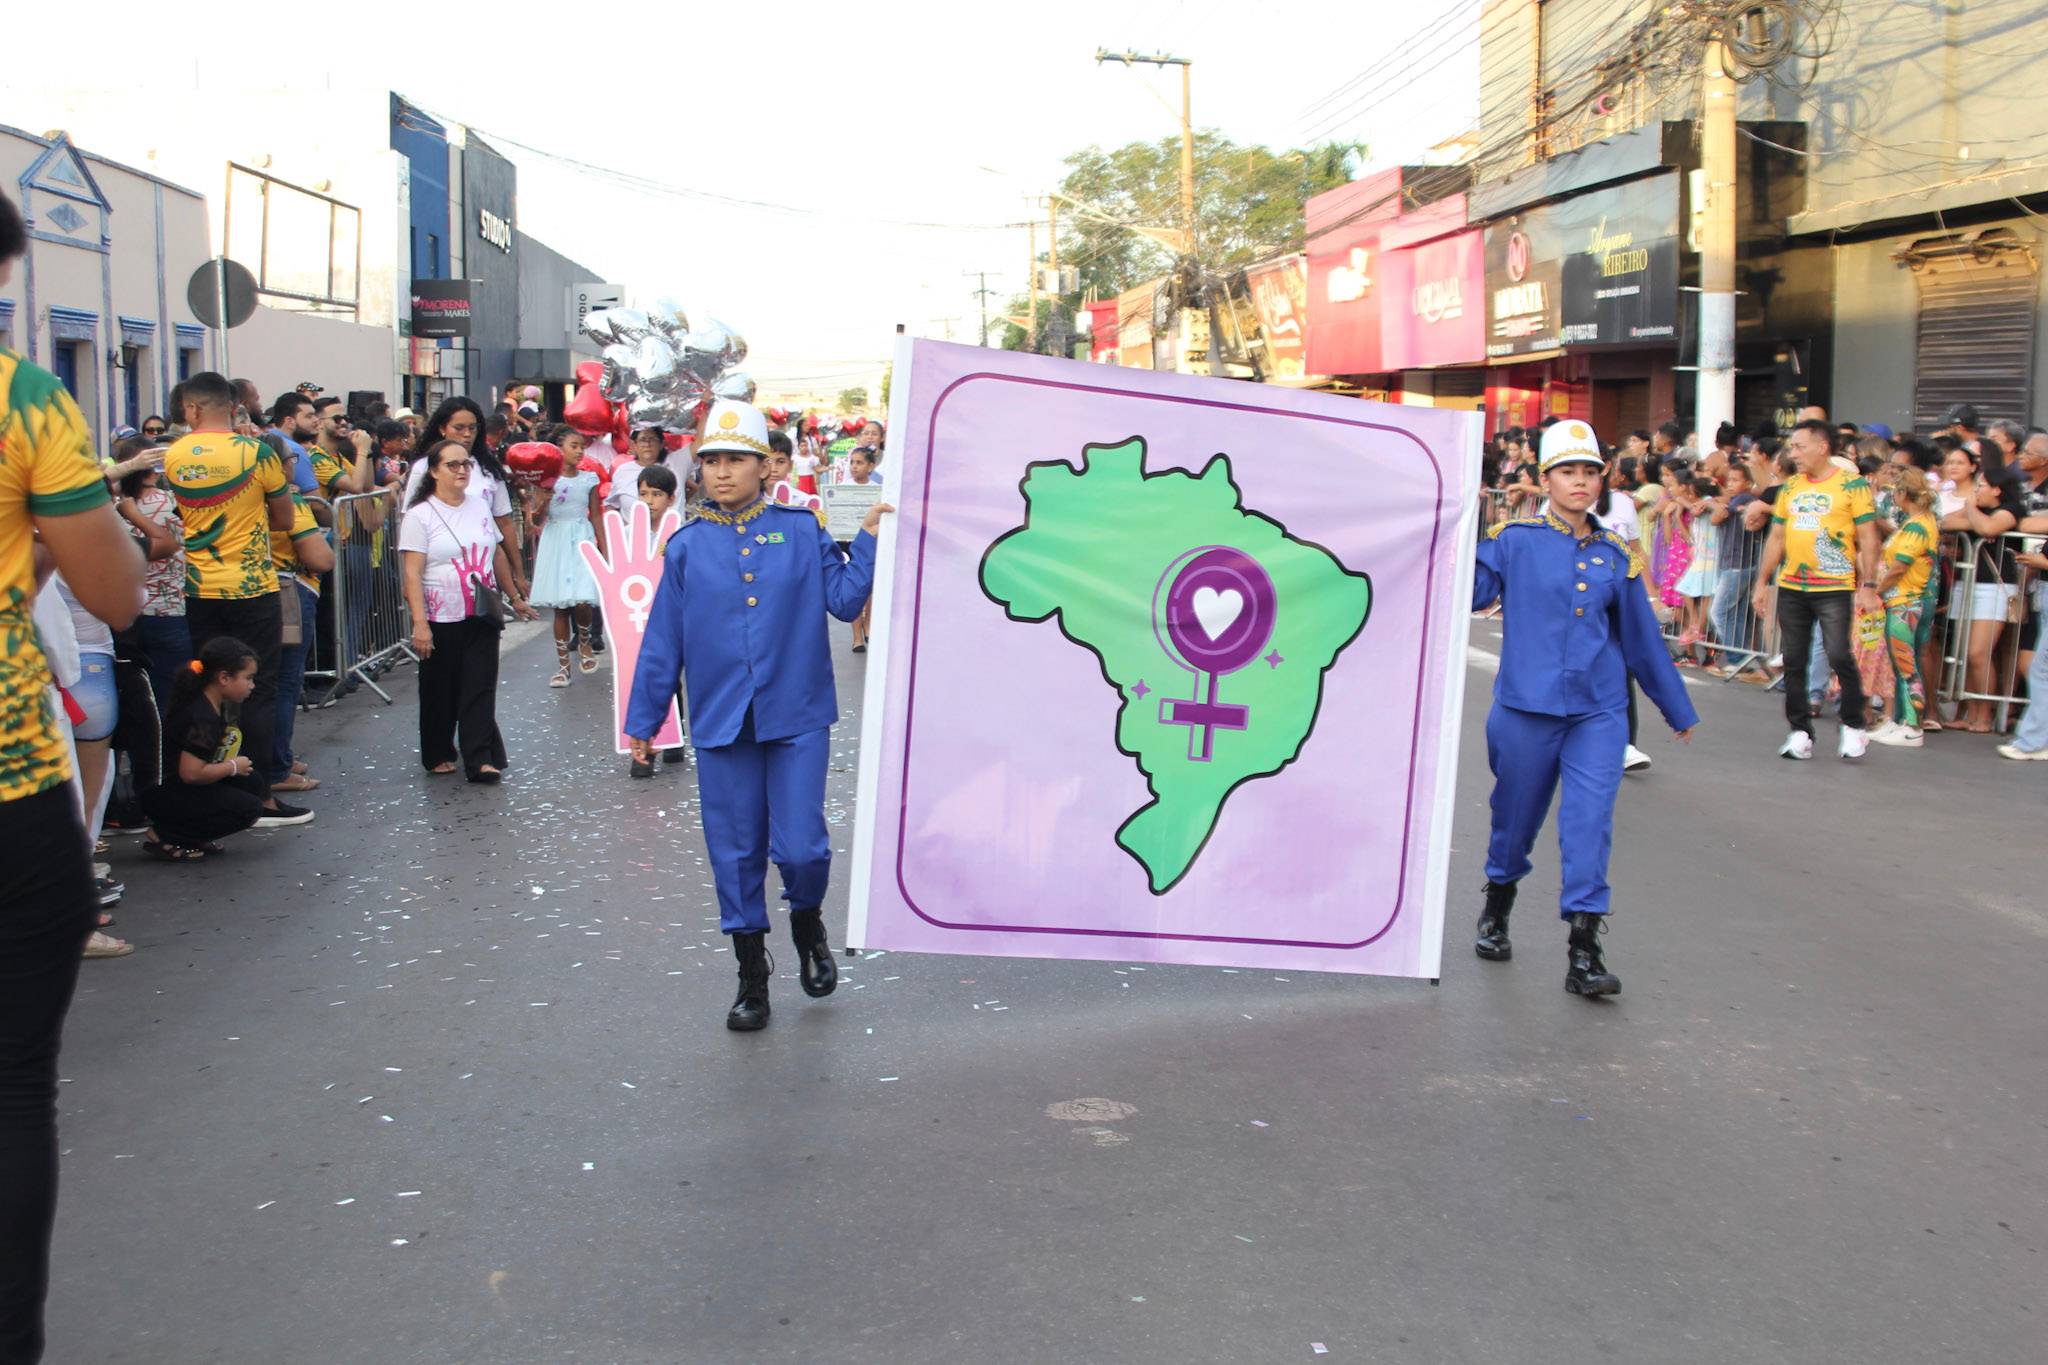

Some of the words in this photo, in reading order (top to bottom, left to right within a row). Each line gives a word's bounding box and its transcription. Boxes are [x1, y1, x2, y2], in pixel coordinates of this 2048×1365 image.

[1601, 248, 1648, 277] RIBEIRO
[424, 298, 470, 312] MORENA
[444, 309, 471, 318] MAKES
